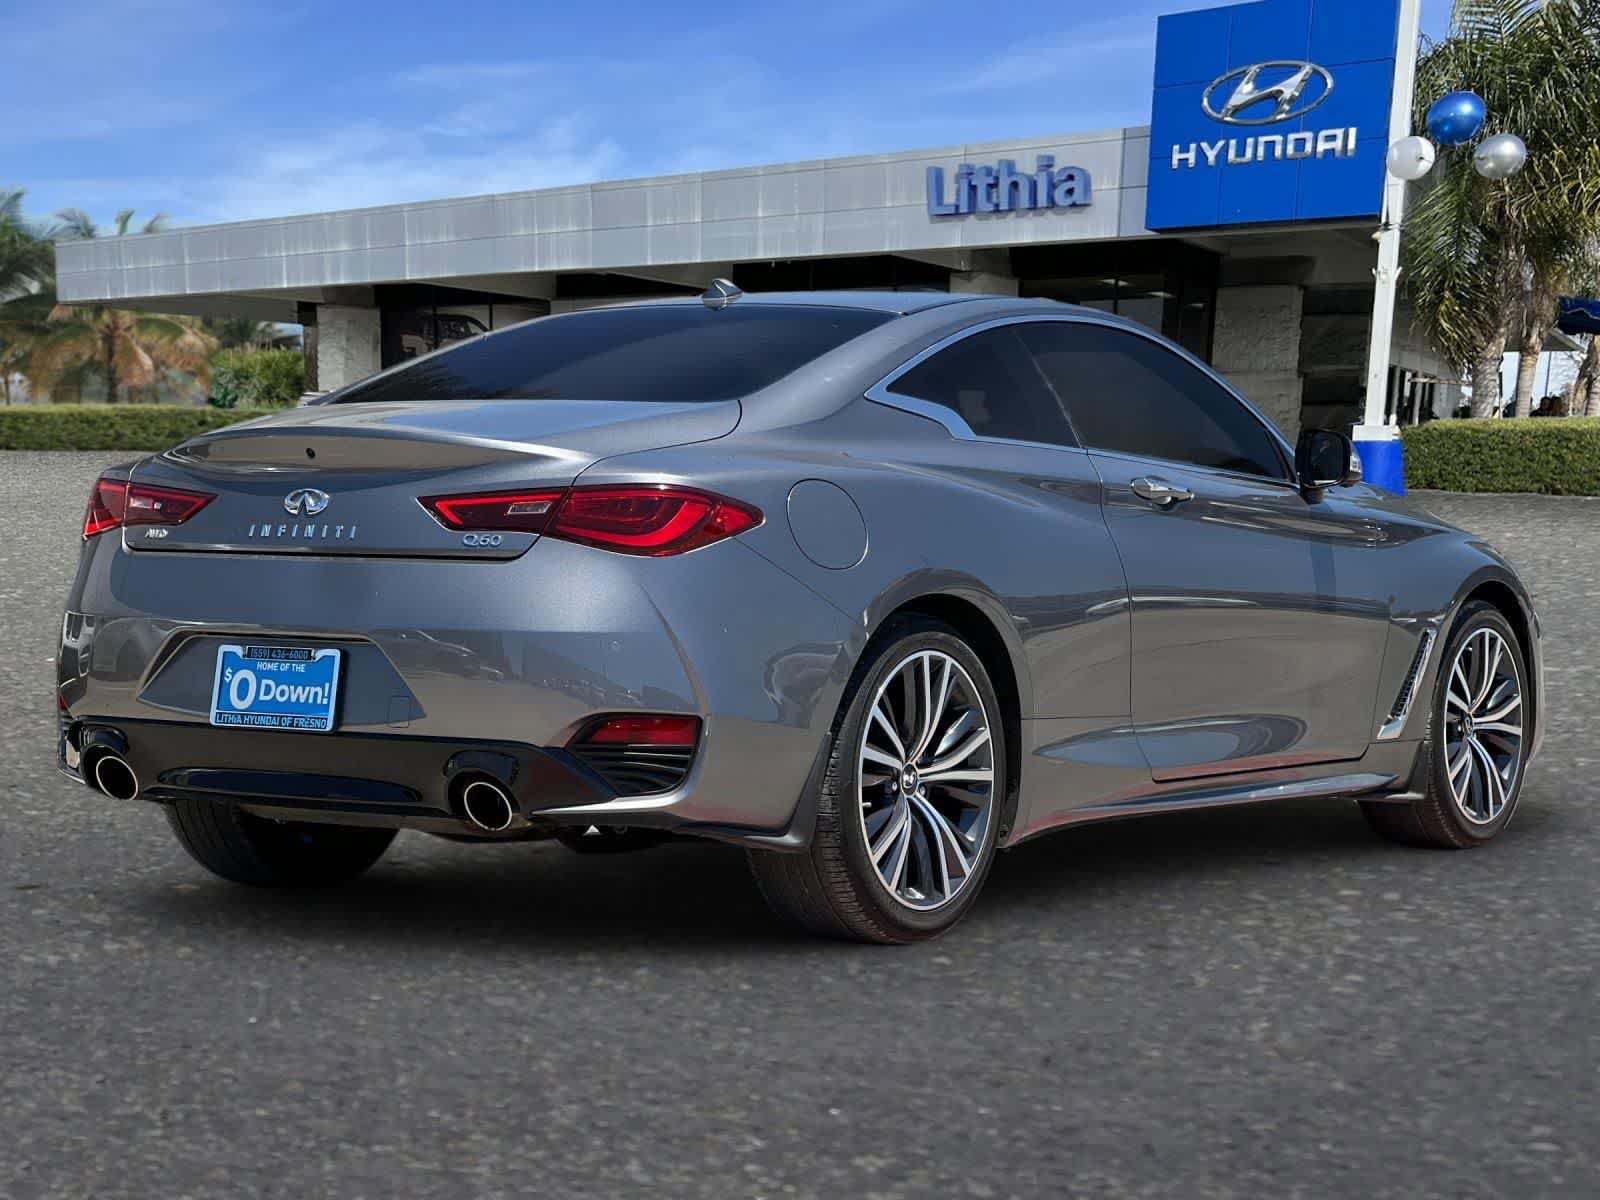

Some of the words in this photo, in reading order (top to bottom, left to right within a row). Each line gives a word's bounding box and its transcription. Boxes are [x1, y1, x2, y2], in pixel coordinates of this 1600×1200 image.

[1171, 127, 1357, 169] HYUNDAI
[926, 155, 1091, 217] Lithia
[248, 524, 356, 538] INFINITI
[463, 533, 502, 546] Q60
[256, 662, 278, 671] HOME
[279, 663, 290, 671] OF
[291, 664, 306, 672] THE
[258, 679, 330, 705] Down!
[243, 714, 280, 727] HYUNDAI
[281, 716, 293, 727] OF
[293, 718, 327, 729] FRESNO
